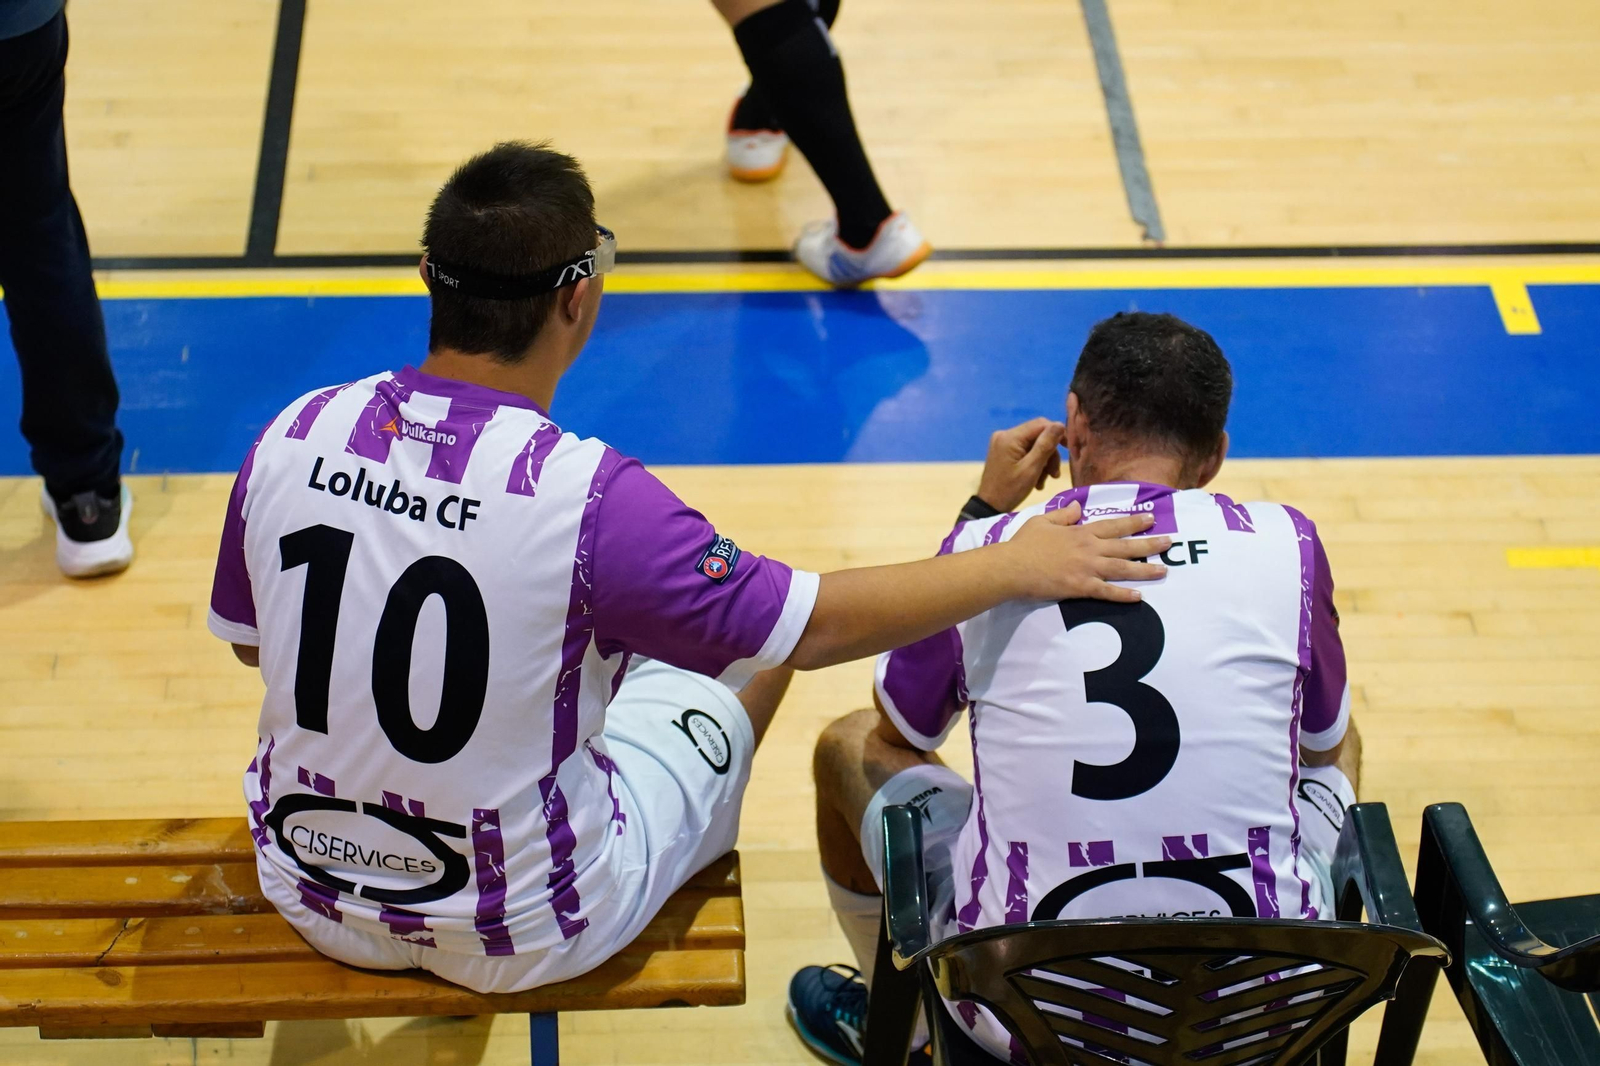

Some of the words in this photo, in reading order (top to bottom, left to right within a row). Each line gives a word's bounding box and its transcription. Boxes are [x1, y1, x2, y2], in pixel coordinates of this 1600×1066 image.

[401, 421, 457, 446] Vulkano
[308, 456, 428, 523] Loluba
[436, 495, 482, 532] CF
[1159, 539, 1209, 567] CF
[279, 523, 490, 764] 10
[1057, 597, 1181, 801] 3
